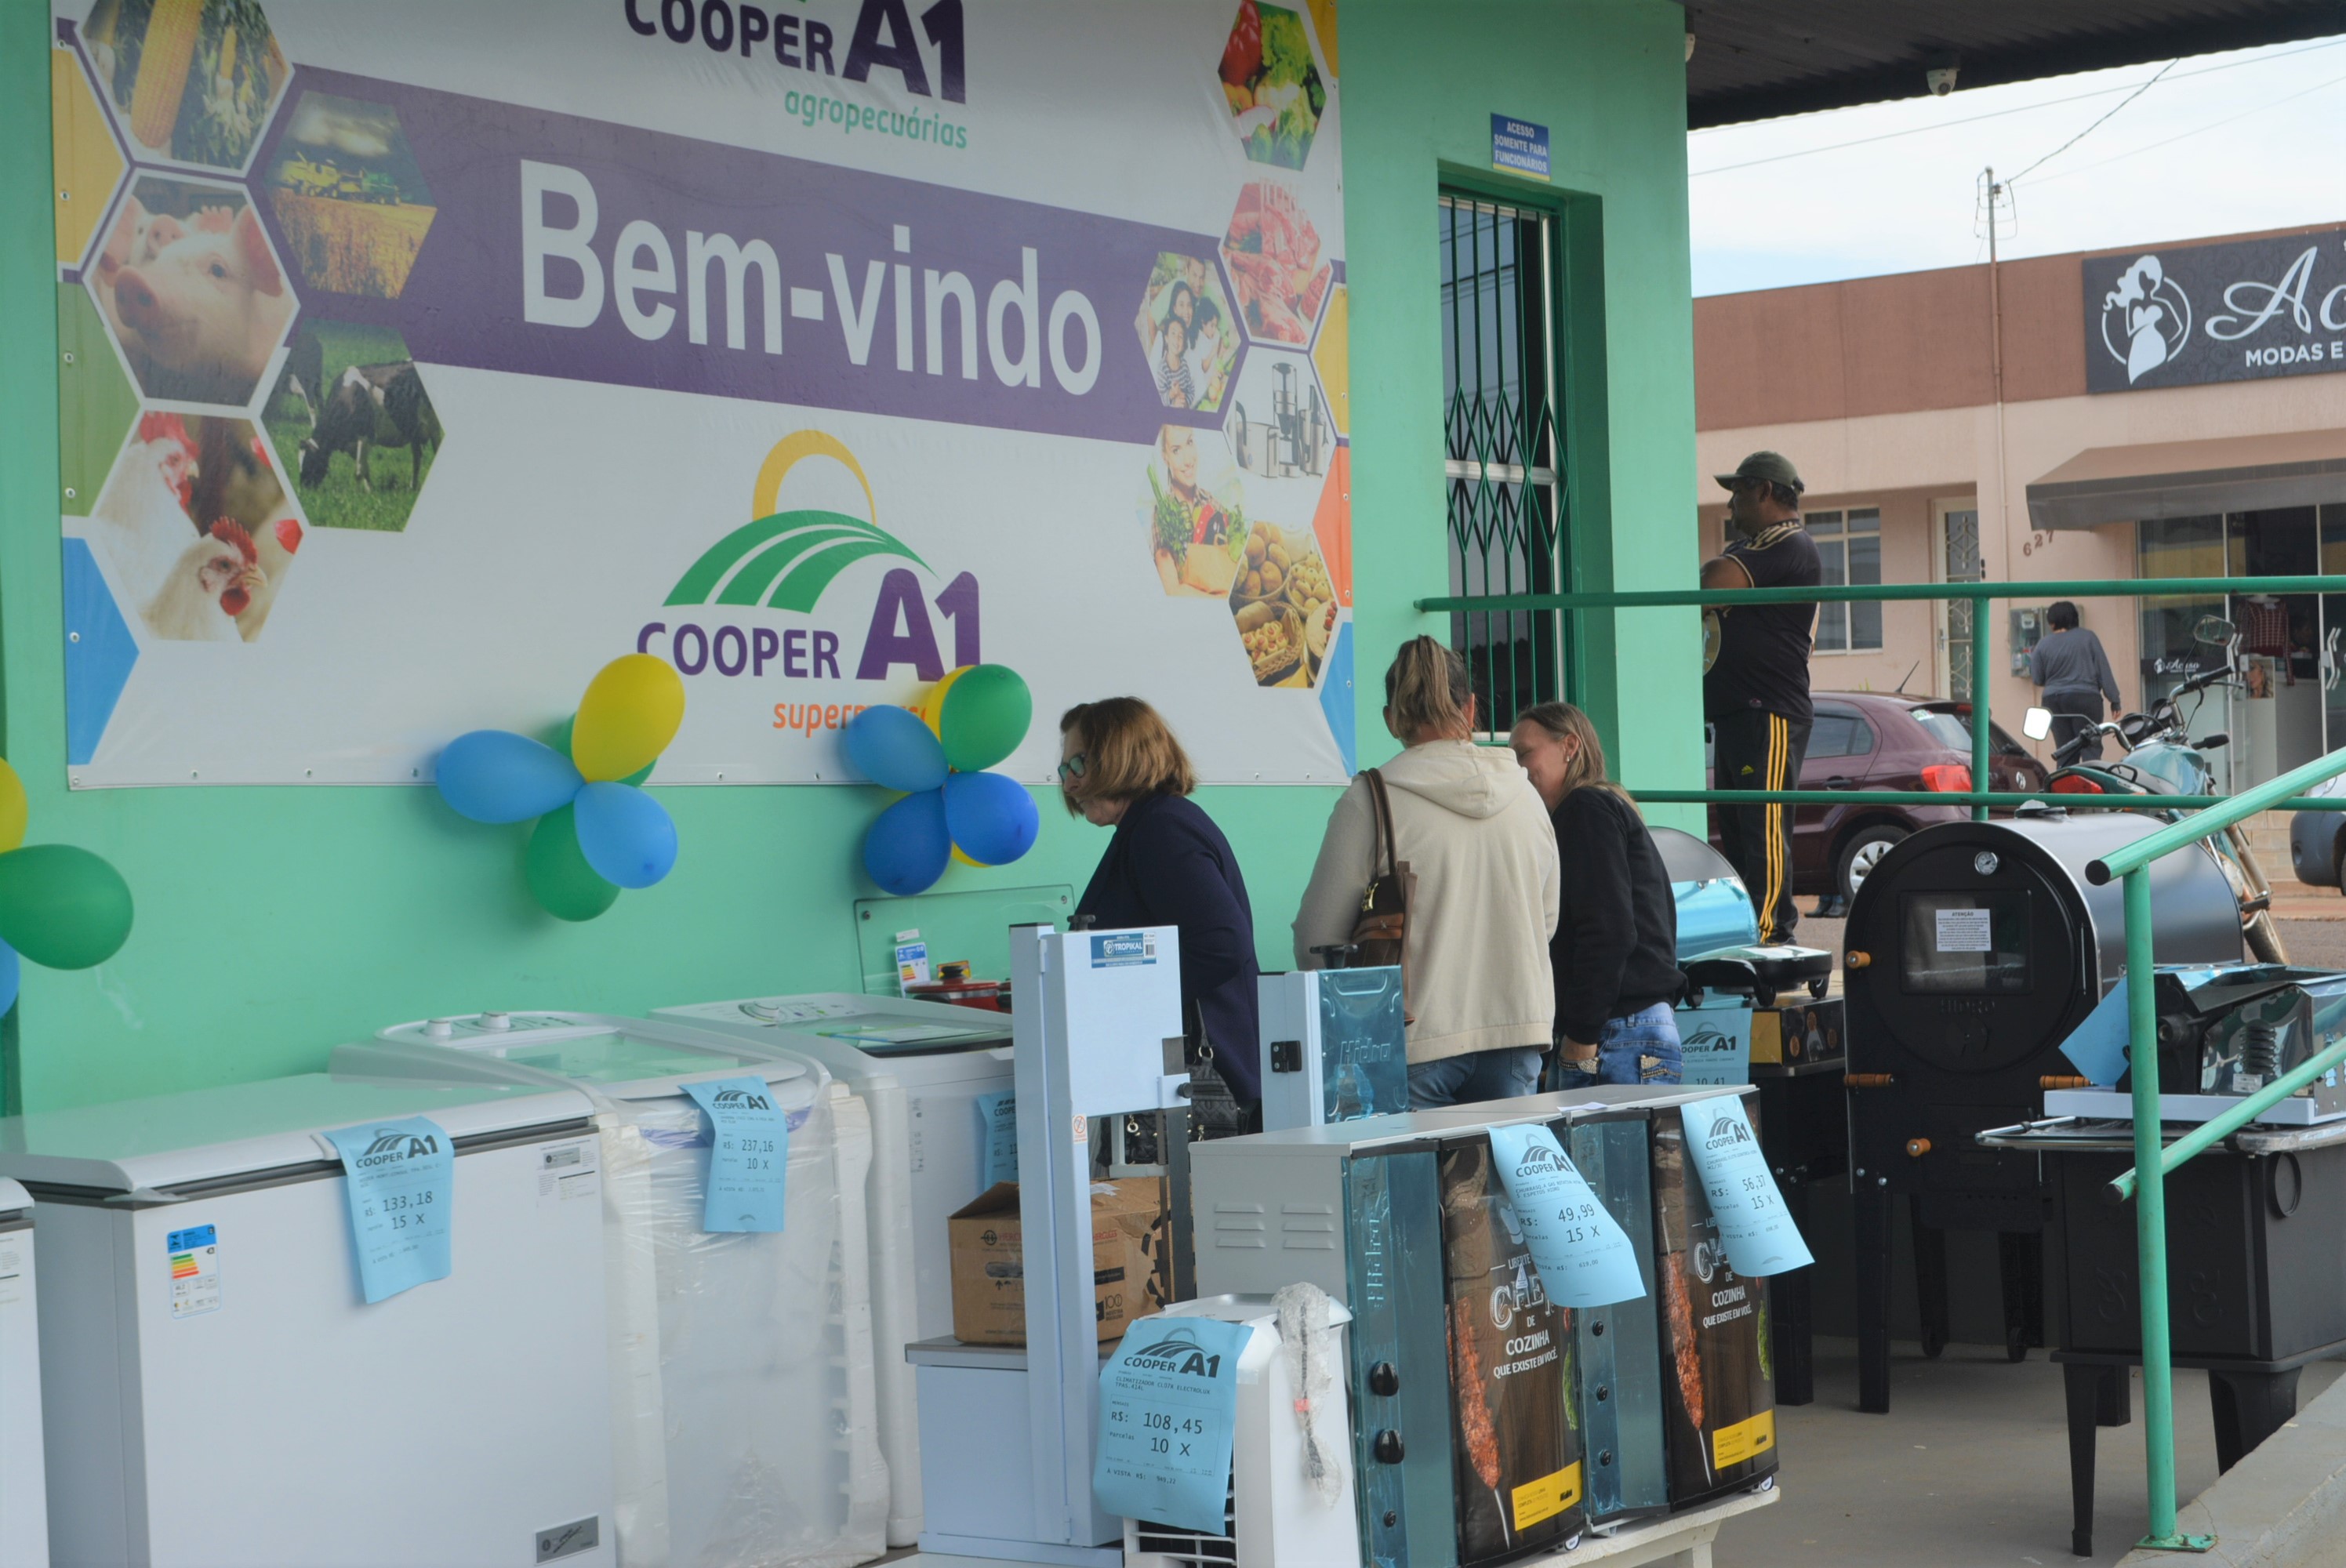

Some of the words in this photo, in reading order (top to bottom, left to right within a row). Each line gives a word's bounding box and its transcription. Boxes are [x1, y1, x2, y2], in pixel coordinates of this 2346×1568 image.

[625, 0, 836, 77] COOPER
[841, 0, 967, 104] A1
[784, 90, 968, 149] agropecuárias
[1506, 122, 1534, 139] ACESSO
[1494, 133, 1527, 152] SOMENTE
[1529, 142, 1548, 157] PARA
[520, 159, 1102, 396] Bem-vindo
[2245, 343, 2324, 368] MODAS
[2330, 340, 2344, 359] E
[855, 568, 981, 682] A1
[1114, 942, 1142, 951] TROPIKAL
[1681, 1045, 1709, 1054] OOPER
[1712, 1036, 1737, 1051] A1
[746, 1095, 770, 1110] A1
[742, 1139, 774, 1153] 237,16
[1705, 1135, 1735, 1150] COOPER
[1733, 1122, 1751, 1142] A1
[356, 1152, 404, 1168] COOPER
[407, 1134, 438, 1159] A1
[746, 1158, 758, 1169] 10
[1516, 1163, 1556, 1178] COOPER
[1552, 1153, 1574, 1172] A1
[1711, 1188, 1729, 1197] R$:
[1742, 1174, 1767, 1192] 56,37
[383, 1190, 433, 1212] 133,18
[1751, 1196, 1764, 1210] 15
[391, 1215, 407, 1230] 15
[1520, 1218, 1538, 1226] R$:
[1558, 1203, 1595, 1222] 49,99
[1566, 1227, 1584, 1243] 15
[1578, 1259, 1599, 1269] 619,00
[1725, 1272, 1734, 1283] DE
[1712, 1285, 1746, 1308] COZINHA
[1527, 1315, 1536, 1327] DE
[1703, 1316, 1716, 1329] QUE
[1716, 1310, 1733, 1323] EXISTE
[1733, 1308, 1741, 1318] EM
[1505, 1330, 1550, 1356] COZINHA
[1124, 1357, 1176, 1372] COOPER
[1179, 1352, 1221, 1378] A1
[1494, 1363, 1512, 1379] QUE
[1512, 1356, 1537, 1374] EXISTE
[1537, 1354, 1545, 1367] EM
[1116, 1376, 1155, 1386] CLIMATIZADOR
[1177, 1385, 1211, 1395] ELECTROLUX
[1111, 1411, 1128, 1423] R$:
[1143, 1412, 1203, 1434] 108,45
[1109, 1432, 1135, 1440] Parcelas
[1150, 1437, 1169, 1454] 10
[1113, 1469, 1131, 1478] VISTA
[1135, 1472, 1146, 1481] R$:
[1156, 1475, 1176, 1484] 949,22
